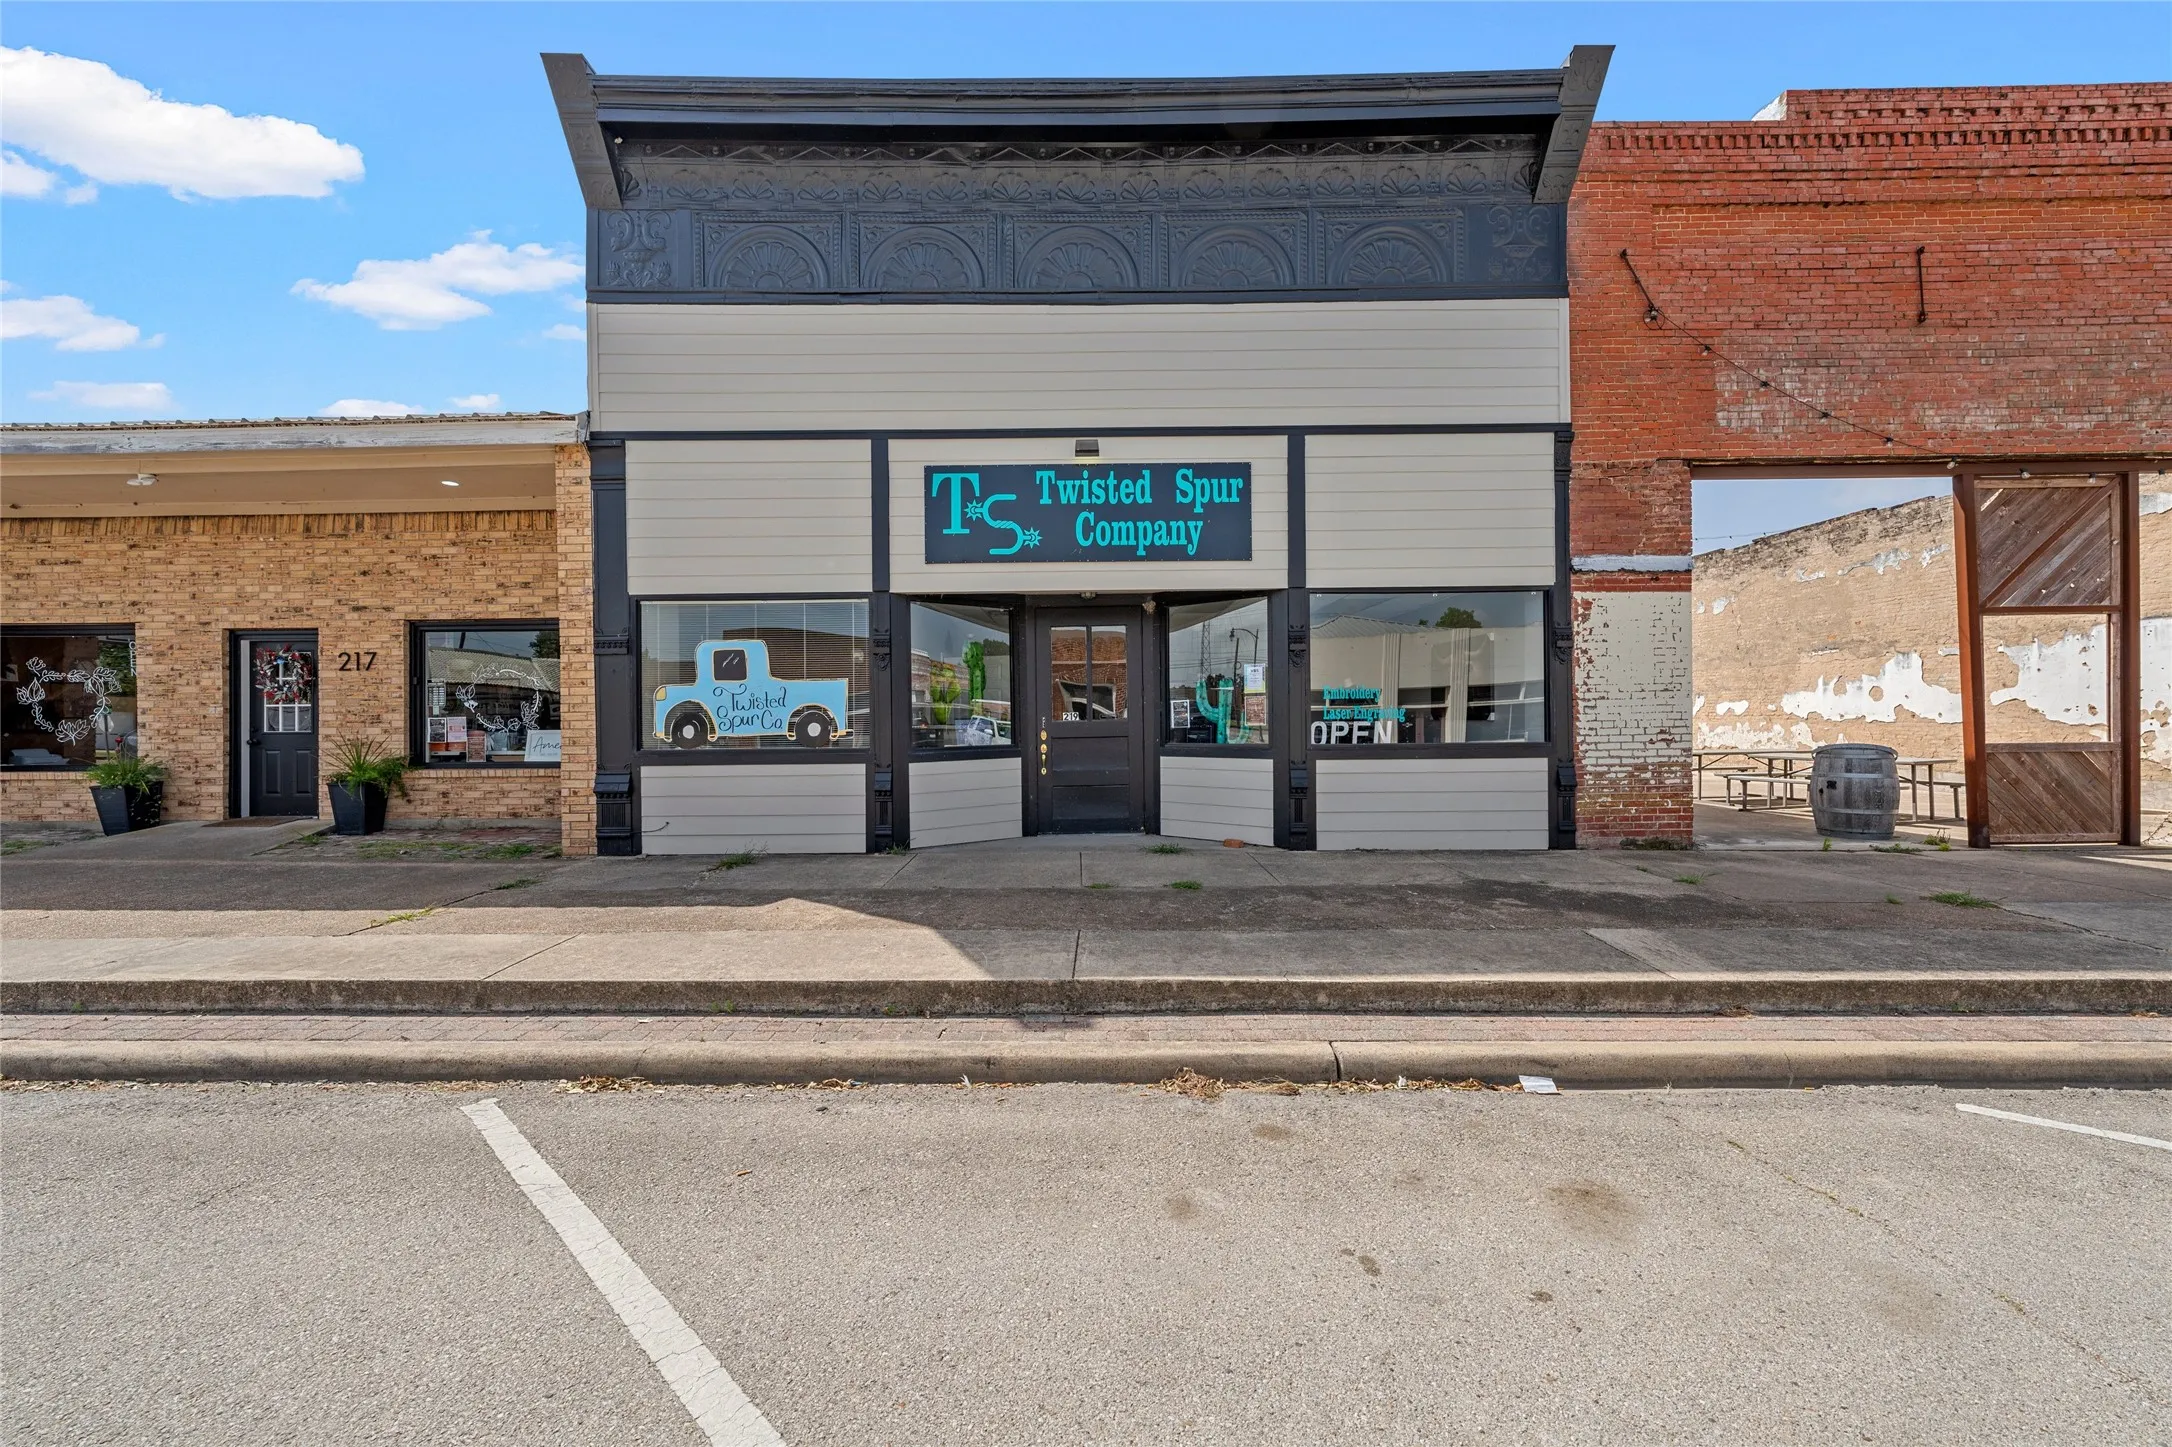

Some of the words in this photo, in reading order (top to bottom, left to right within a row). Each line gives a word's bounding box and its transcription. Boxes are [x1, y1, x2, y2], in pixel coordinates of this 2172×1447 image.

[1036, 469, 1152, 504] Twisted
[1175, 468, 1244, 513] Spur
[1075, 511, 1204, 556] Company
[338, 652, 377, 671] 217
[713, 683, 787, 712] Twisted
[1323, 685, 1382, 702] Embroidery
[716, 705, 760, 733] Spur
[1063, 712, 1079, 720] 219
[1323, 705, 1352, 720] Laser
[1353, 704, 1406, 722] Engraving
[532, 736, 561, 753] Ame
